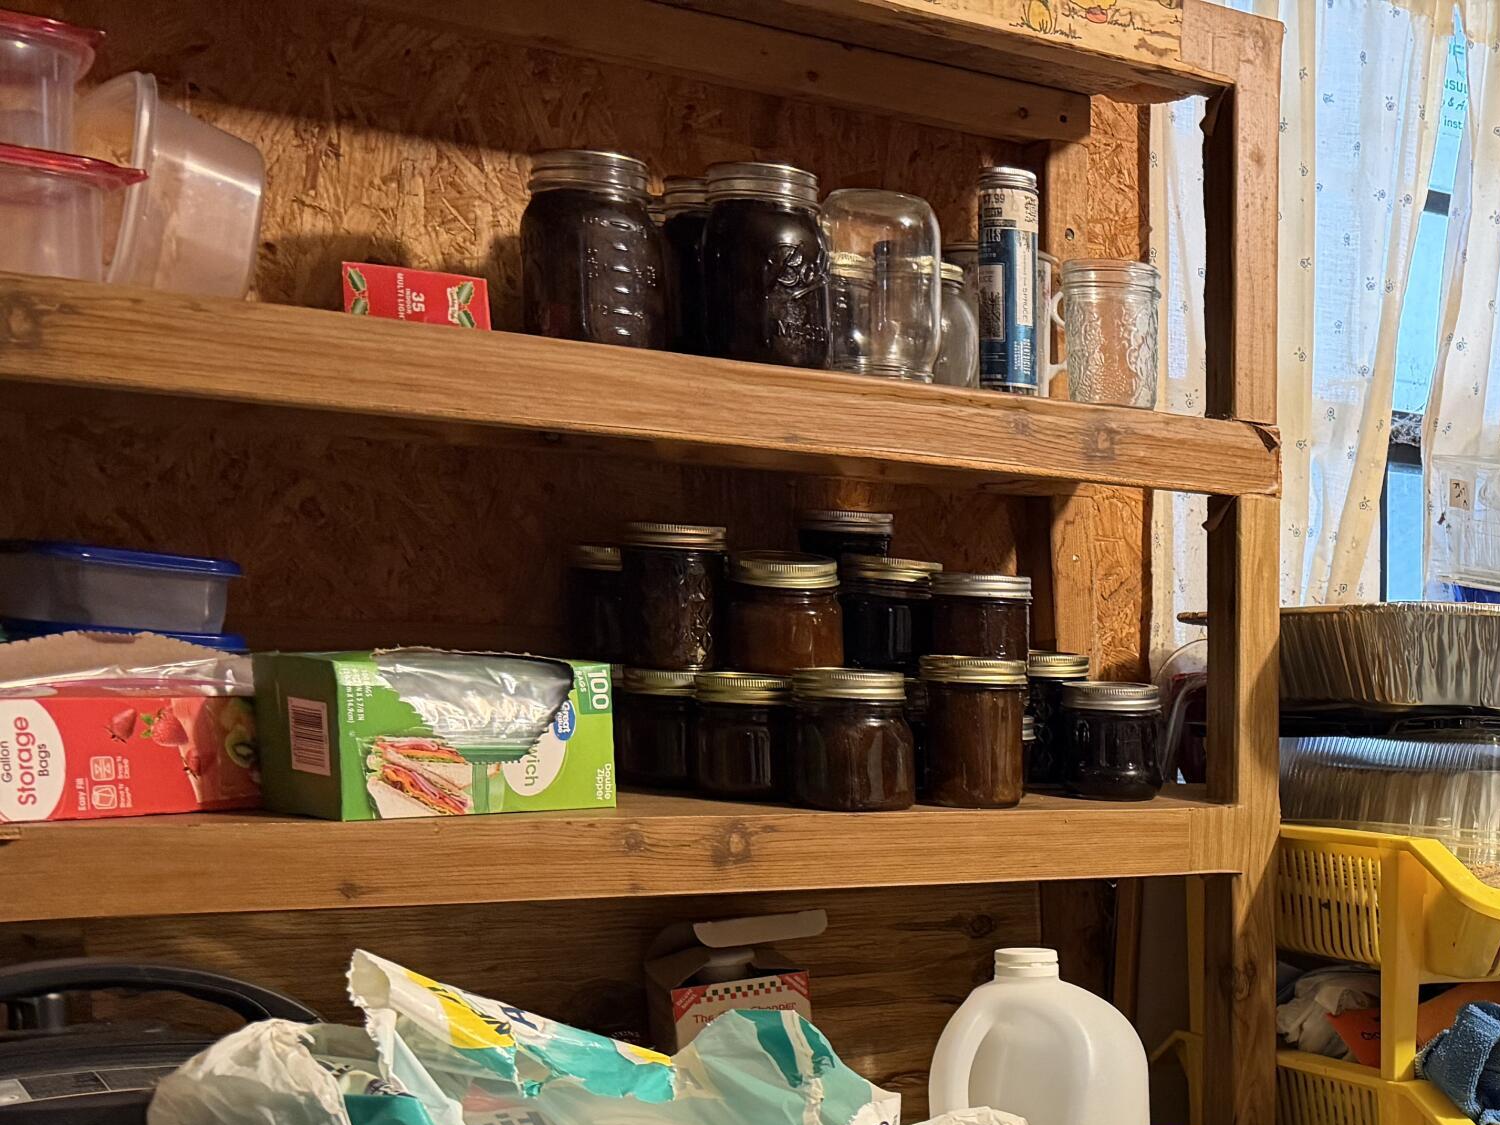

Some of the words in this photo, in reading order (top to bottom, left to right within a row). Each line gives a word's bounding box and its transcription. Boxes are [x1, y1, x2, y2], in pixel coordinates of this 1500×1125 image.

[397, 299, 406, 321] LIGH
[411, 291, 426, 313] 35
[575, 670, 587, 693] BAGS
[587, 669, 610, 710] 100
[562, 702, 571, 733] Great
[1, 740, 12, 783] Gallon
[13, 715, 38, 806] Storage
[38, 743, 51, 777] Bags
[524, 746, 541, 787] wich
[596, 768, 605, 801] Zipper
[604, 763, 612, 800] Double
[77, 794, 88, 812] Easy
[693, 1014, 714, 1024] The
